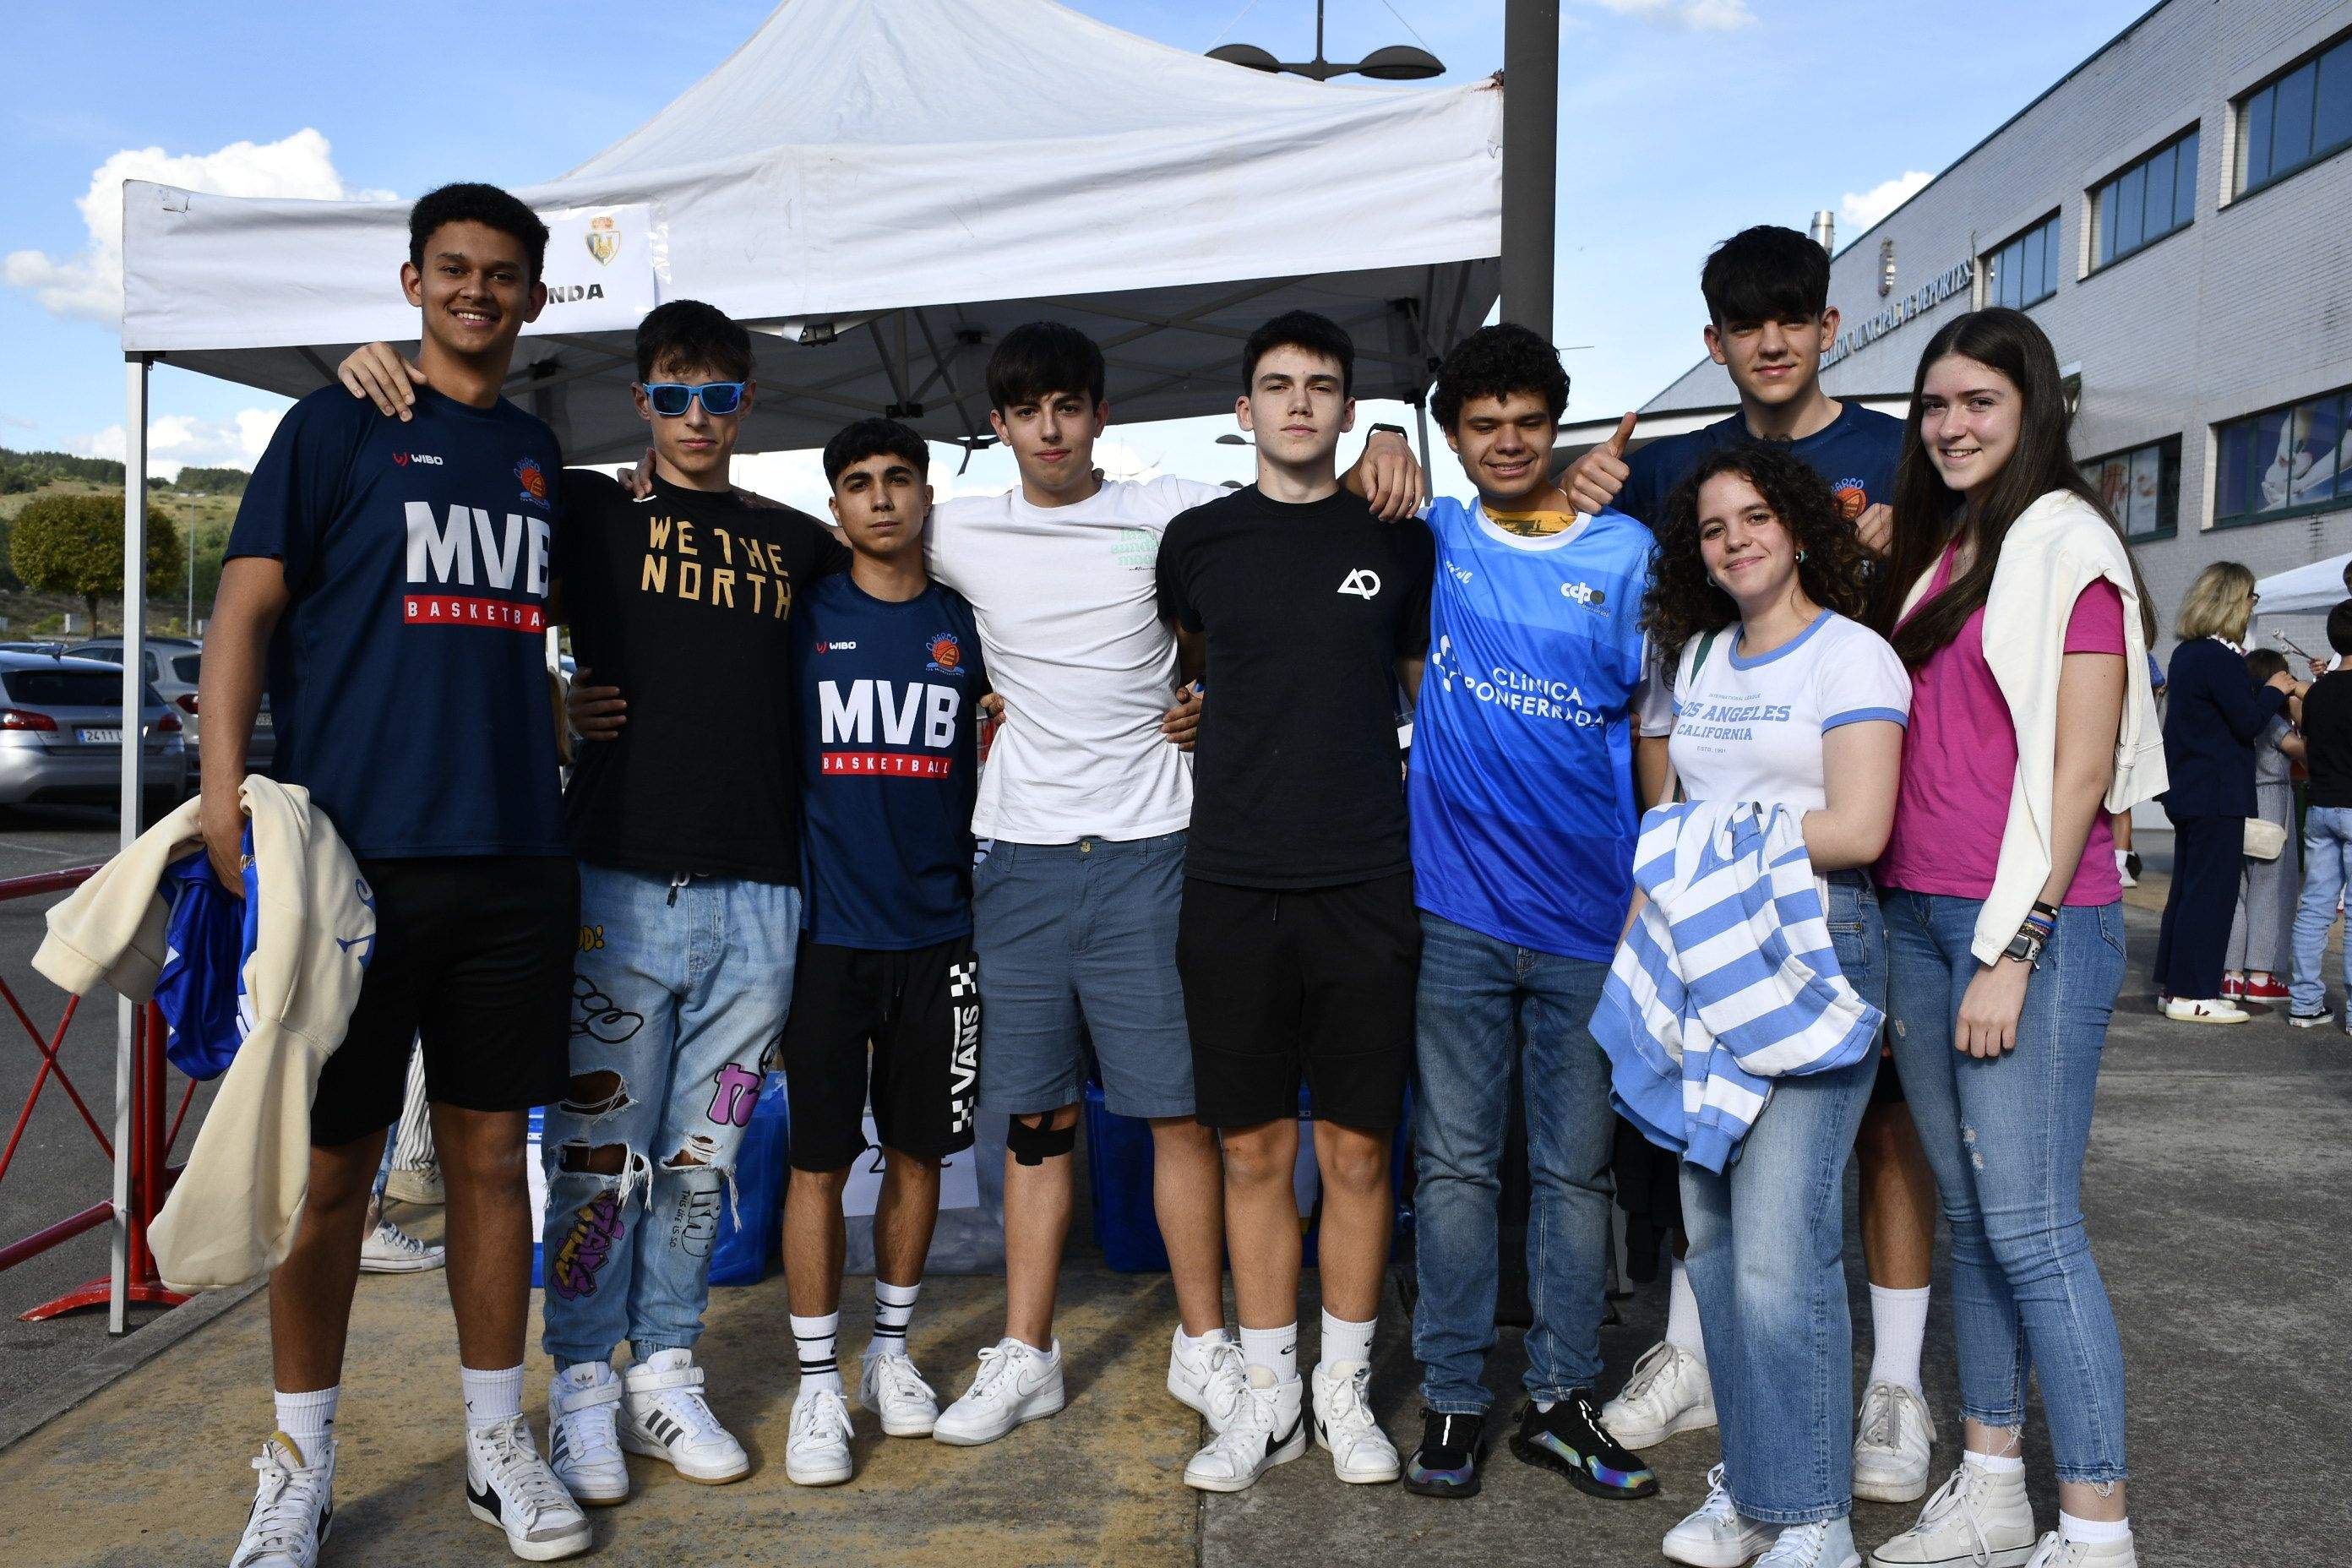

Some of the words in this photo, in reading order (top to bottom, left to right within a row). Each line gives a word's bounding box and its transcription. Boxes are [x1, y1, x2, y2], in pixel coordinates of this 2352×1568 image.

[547, 284, 604, 304] NDA
[411, 454, 444, 466] WIBO
[650, 516, 699, 556] WE
[405, 501, 551, 599] MVB
[641, 553, 792, 621] NORTH
[407, 602, 547, 627] BASKETBA
[829, 640, 857, 650] WIBO
[818, 679, 961, 748] MVB
[1701, 704, 1792, 722] ANGELES
[1677, 724, 1753, 741] CALIFORNIA
[824, 757, 949, 774] BASKETBALL
[950, 1004, 979, 1095] VANS
